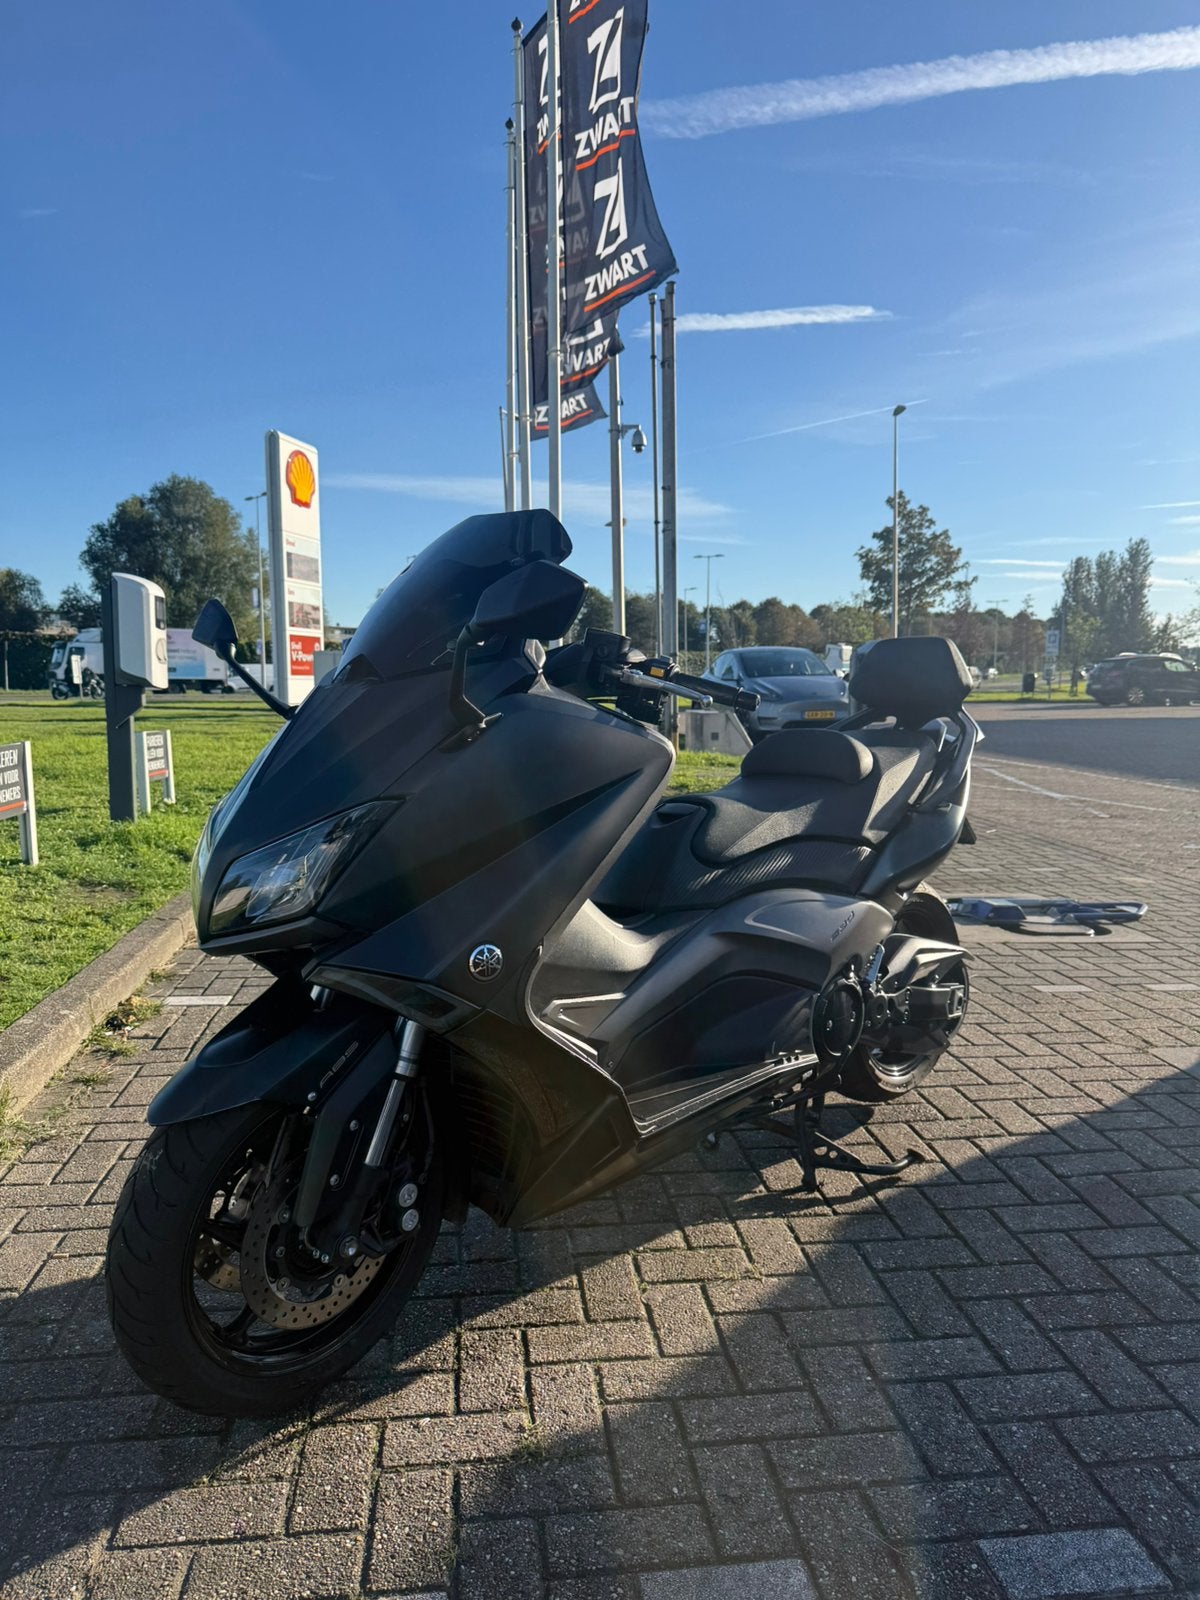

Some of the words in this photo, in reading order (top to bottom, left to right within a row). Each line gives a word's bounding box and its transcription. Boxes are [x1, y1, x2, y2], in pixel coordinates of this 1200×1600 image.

[575, 96, 634, 160] ZWAT
[584, 243, 649, 301] ZWART
[536, 393, 588, 422] ZART
[0, 749, 18, 768] EREN
[4, 769, 20, 785] VOOR
[320, 1040, 359, 1089] ABS
